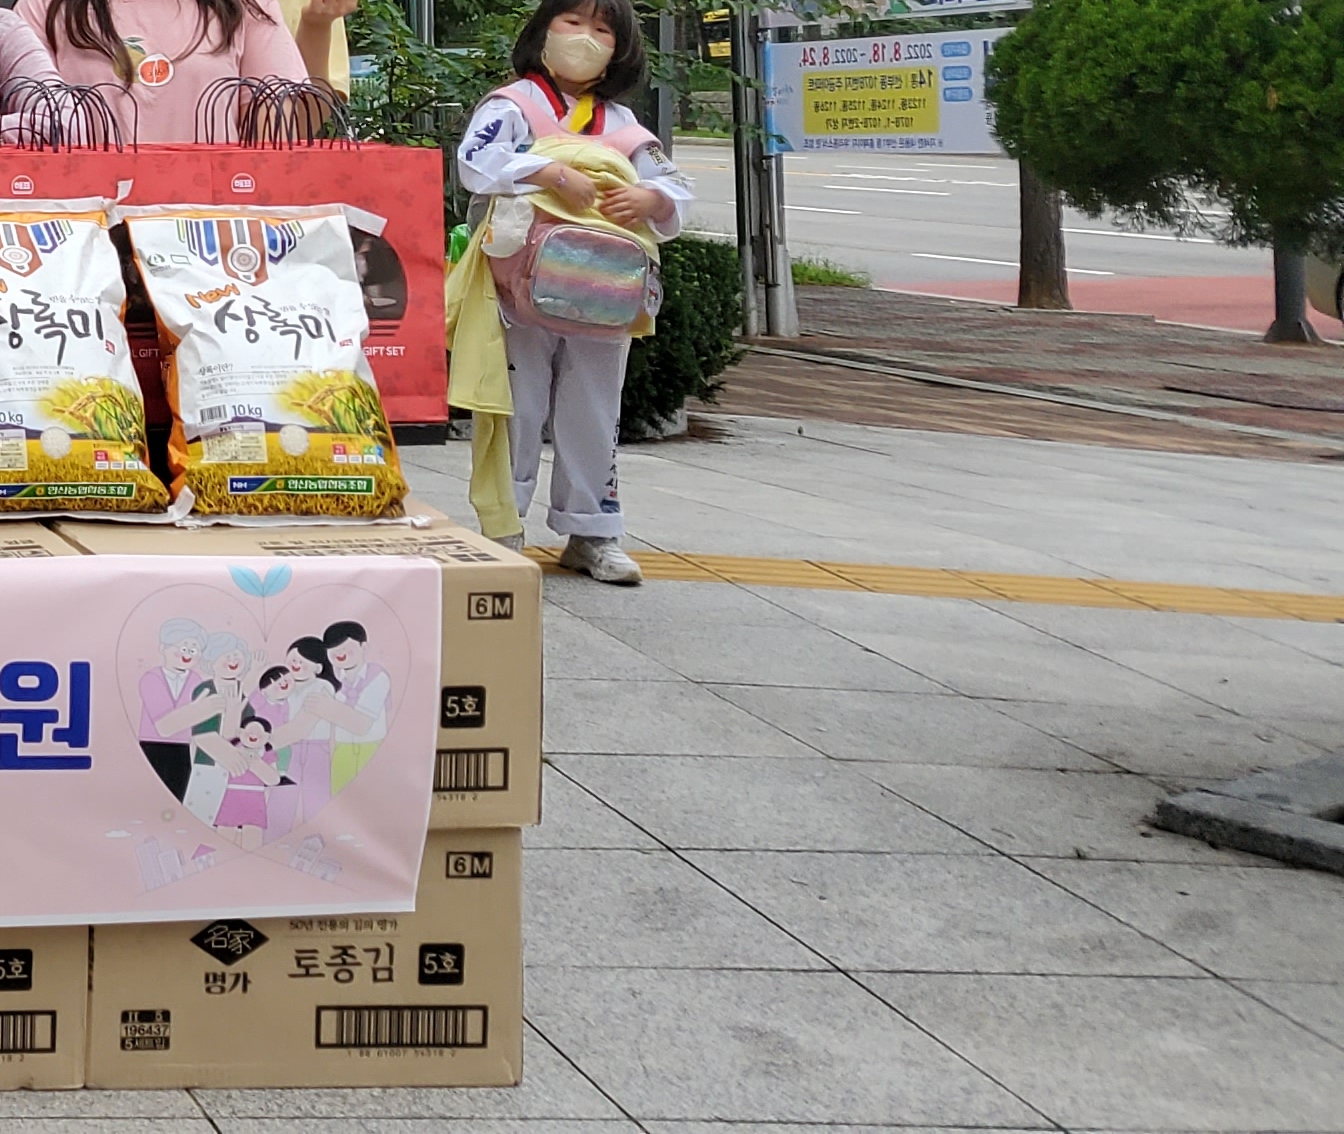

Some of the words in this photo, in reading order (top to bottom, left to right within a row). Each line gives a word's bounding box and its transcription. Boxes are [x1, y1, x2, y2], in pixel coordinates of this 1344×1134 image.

[184, 282, 241, 308] New
[214, 295, 337, 361] 상록미
[139, 348, 160, 357] GIFT
[363, 346, 385, 356] GIFT
[386, 346, 406, 356] SET
[8, 411, 23, 425] kg
[232, 404, 245, 416] 10
[248, 404, 262, 418] kg
[287, 480, 367, 490] 안산농업협동조합
[446, 694, 481, 717] 5호
[204, 924, 254, 954] 名家
[287, 942, 395, 984] 토종김
[424, 952, 460, 975] 5호
[204, 971, 252, 995] 명가
[123, 1024, 170, 1036] 196437
